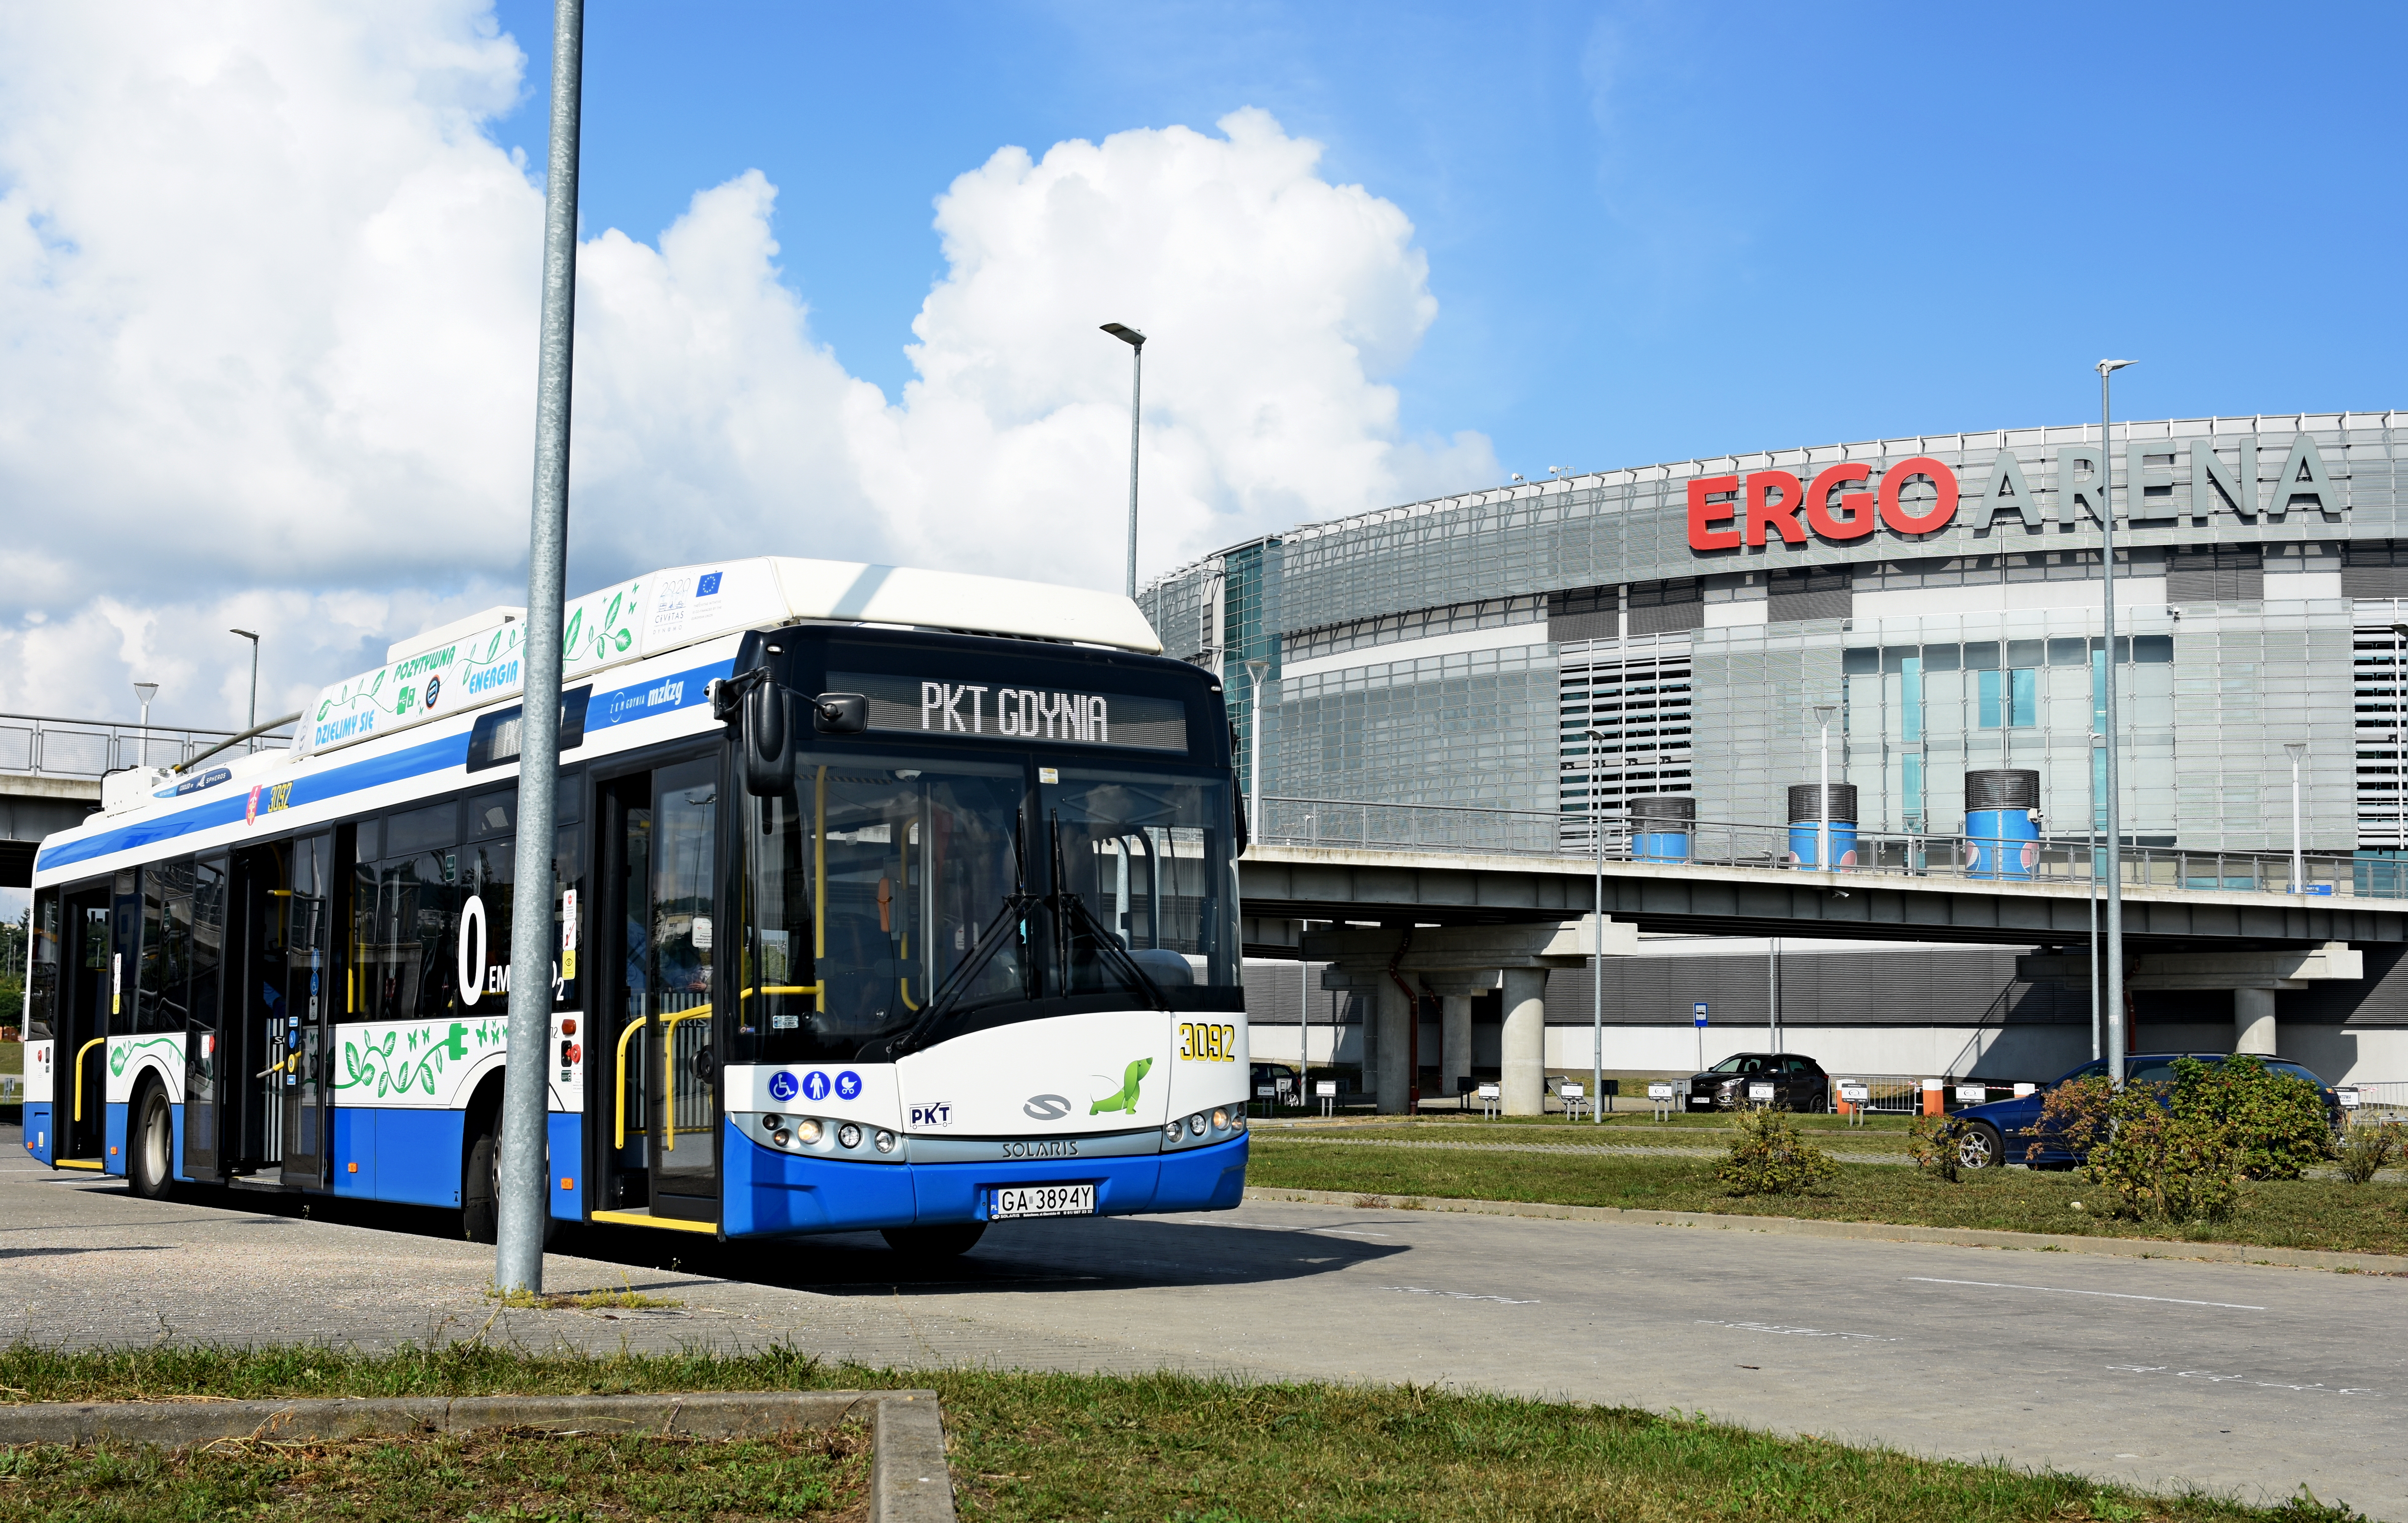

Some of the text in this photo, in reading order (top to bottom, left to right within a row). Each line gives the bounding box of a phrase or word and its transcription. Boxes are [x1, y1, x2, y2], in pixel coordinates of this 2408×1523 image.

[1687, 436, 2342, 551] ERGO ARENA
[660, 578, 691, 597] 2020
[393, 645, 456, 683] POZYTYWNĄ
[469, 660, 518, 695] ENERGIĄ
[626, 695, 645, 709] GDYNIA
[647, 679, 684, 707] mzkzg
[315, 709, 375, 746] DZIELIMY SIĘ
[922, 682, 1108, 742] PKT GDYNIA
[179, 783, 191, 791] COOLED
[206, 772, 226, 784] SPHEROS
[268, 780, 294, 813] 3092
[459, 895, 486, 1006] 0
[1179, 1022, 1235, 1062] 3092
[912, 1102, 949, 1124] PKT
[1002, 1141, 1078, 1158] SOLARIS
[1002, 1190, 1028, 1211] GA
[1036, 1187, 1091, 1209] 3894Y
